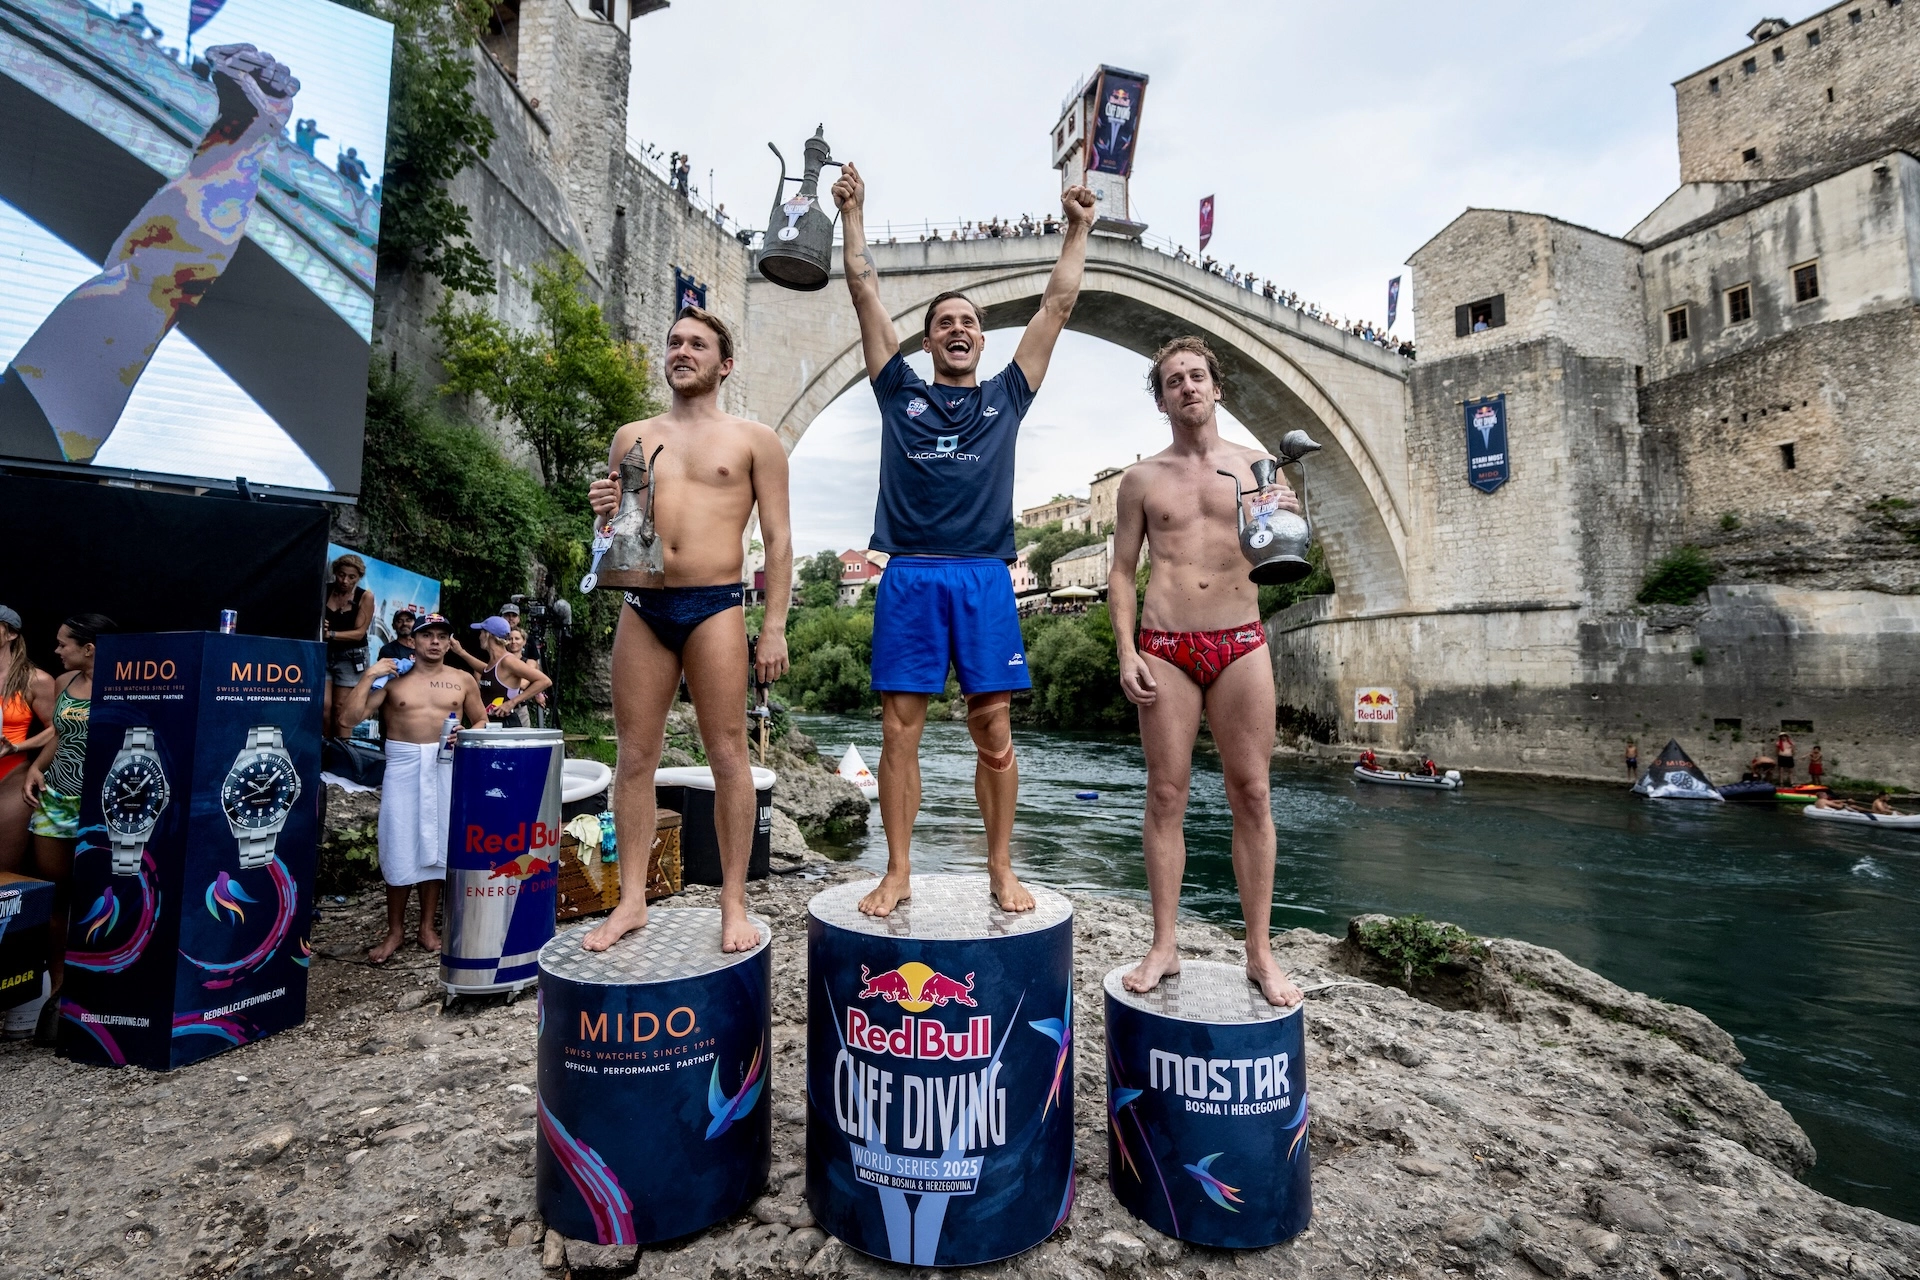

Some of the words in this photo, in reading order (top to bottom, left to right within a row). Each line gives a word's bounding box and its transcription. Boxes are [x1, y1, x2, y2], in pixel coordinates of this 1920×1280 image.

[957, 453, 981, 462] CITY
[1472, 456, 1488, 465] STARI
[1488, 453, 1503, 461] MOST
[1479, 471, 1499, 479] MIDO
[1258, 534, 1265, 543] 3
[585, 577, 592, 588] 2
[116, 660, 175, 680] MIDO
[231, 662, 302, 683] MIDO
[430, 681, 461, 691] MIDO
[1358, 709, 1375, 720] Red
[1376, 709, 1394, 720] Bull
[1666, 760, 1693, 768] MIDO
[465, 822, 526, 854] Red
[466, 883, 526, 897] ENERGY
[0, 970, 34, 990] EADER
[204, 987, 286, 1021] REDBULLCLIFFDIVING.COM
[81, 1013, 150, 1027] REDBULLCLIFFDIVING.COM
[580, 1006, 696, 1043] MIDO
[847, 1006, 915, 1059] Red
[917, 1015, 992, 1061] Bull
[565, 1046, 591, 1059] SWISS
[596, 1052, 647, 1060] WATCHES
[653, 1045, 688, 1058] SINCE
[694, 1038, 716, 1050] 1918
[565, 1061, 598, 1074] OFFICIAL
[603, 1063, 670, 1075] PERFORMANCE
[676, 1052, 715, 1069] PARTNER
[1150, 1048, 1290, 1103] MOSTAR
[834, 1048, 893, 1145] CLIFF
[903, 1061, 1006, 1150] DIVING
[1185, 1100, 1221, 1115] BOSNA
[1224, 1106, 1228, 1115] I
[1231, 1096, 1291, 1115] HERCEGOVINA
[854, 1146, 891, 1171] WORLD
[897, 1157, 939, 1177] SERIES
[943, 1160, 978, 1177] 2025
[859, 1168, 889, 1185] MOSTAR
[891, 1177, 916, 1189] BOSNIA
[918, 1181, 923, 1190] &
[925, 1180, 972, 1191] HERZEGOVINA
